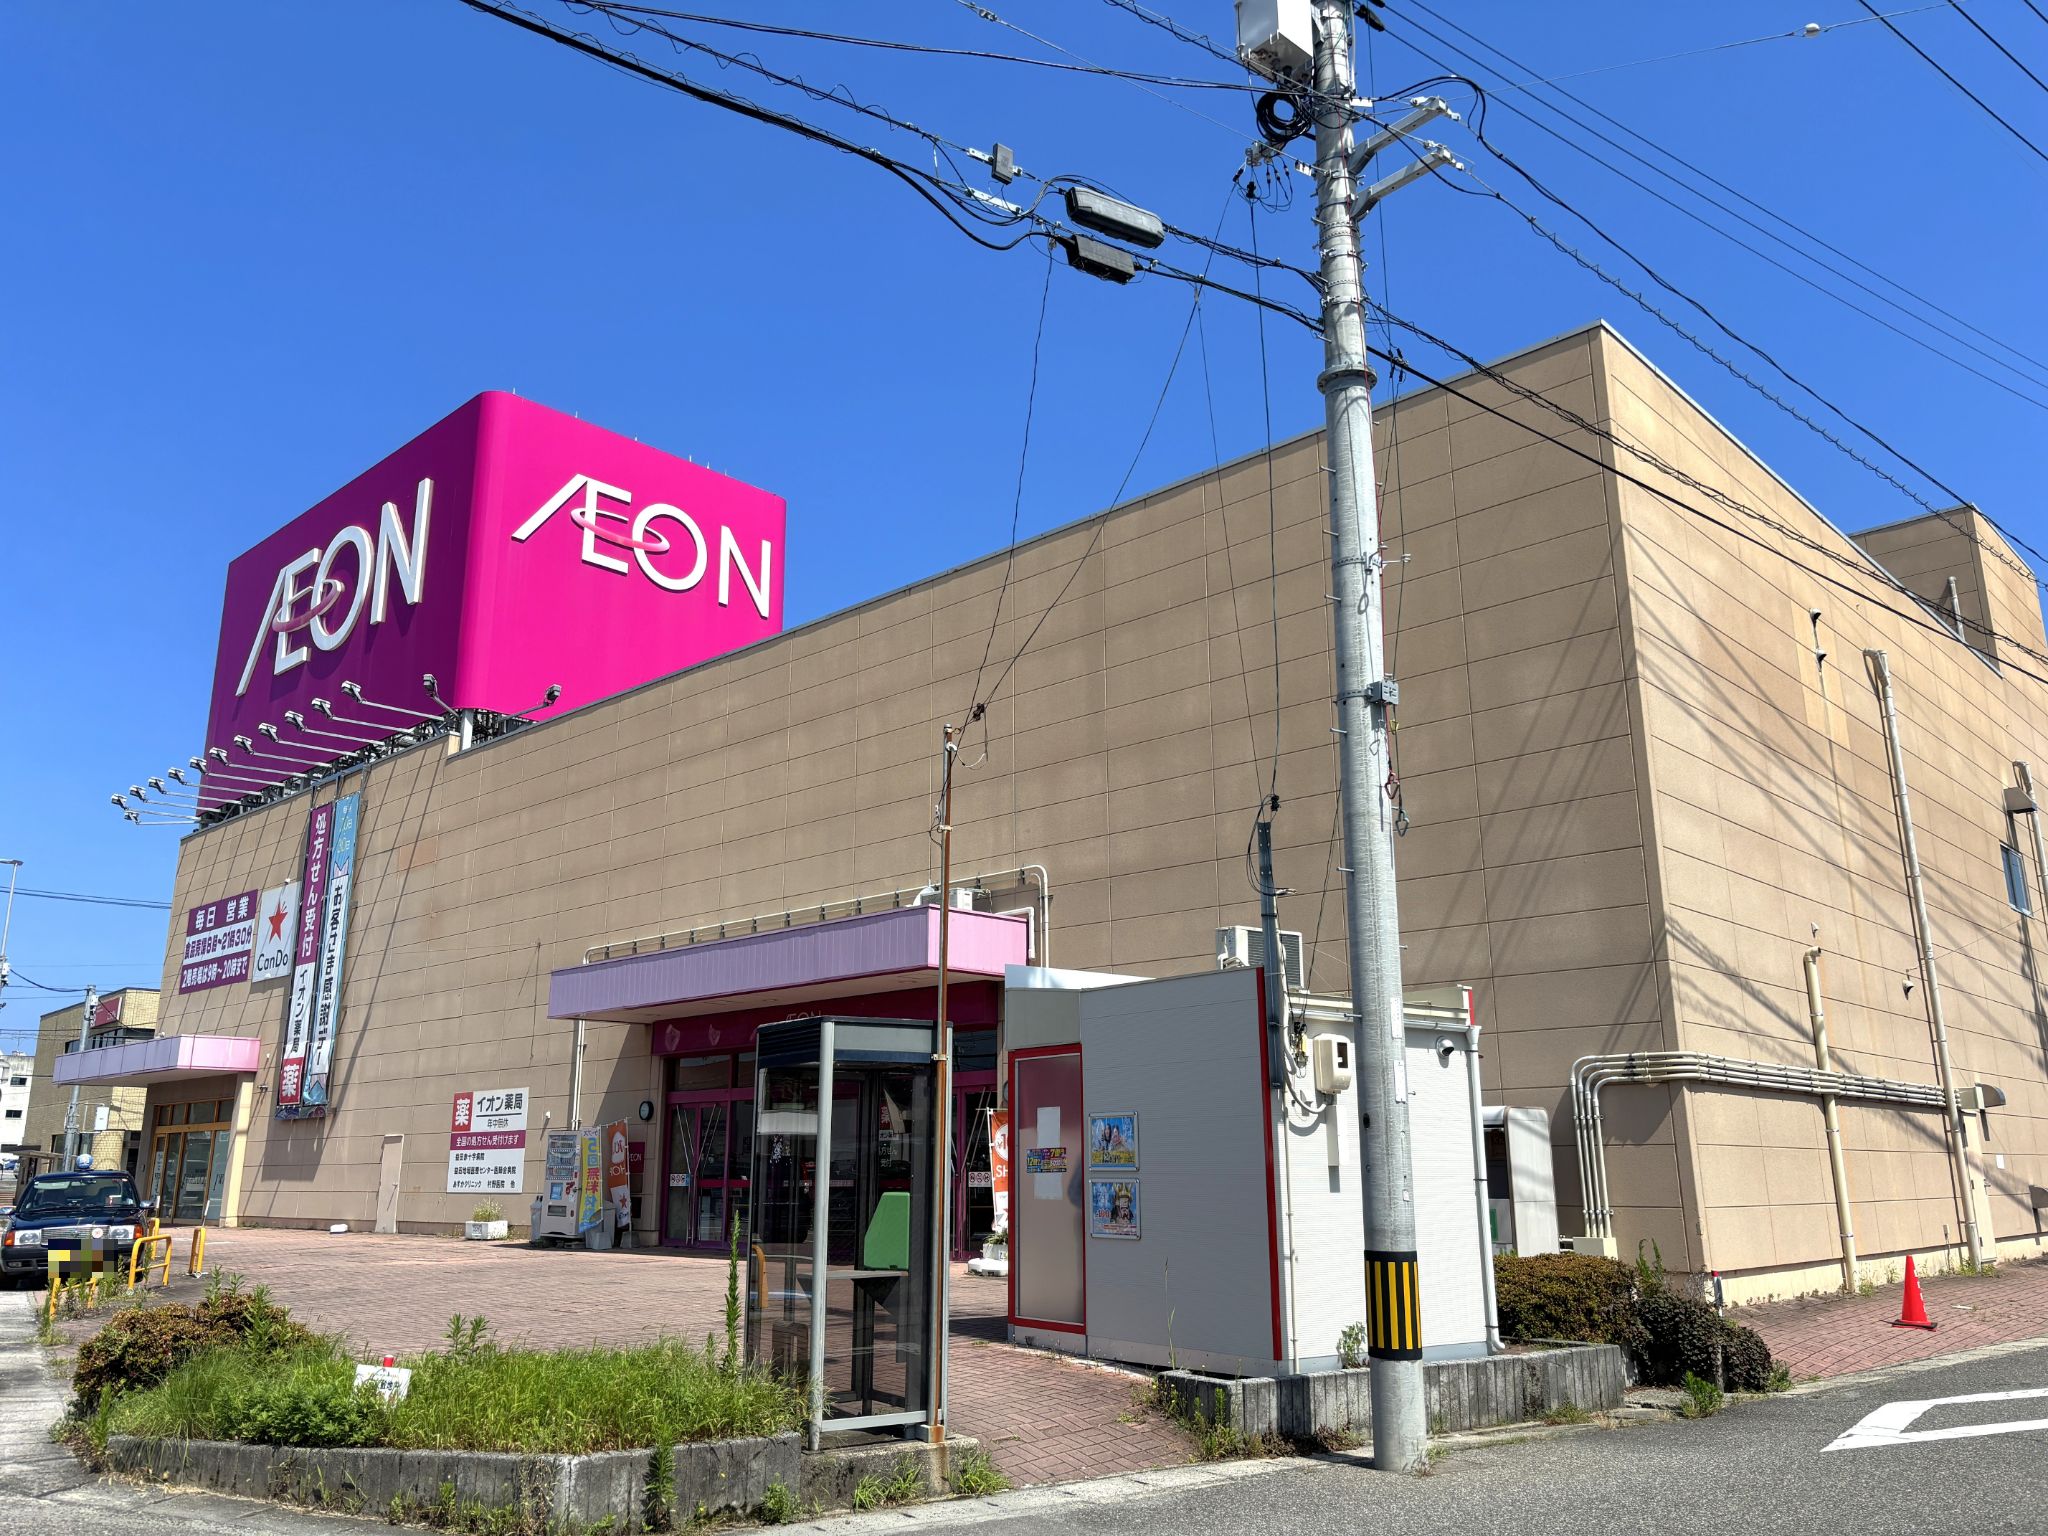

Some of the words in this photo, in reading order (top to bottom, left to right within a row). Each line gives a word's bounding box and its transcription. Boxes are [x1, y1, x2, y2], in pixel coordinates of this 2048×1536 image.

[302, 812, 326, 957] 処方せん受付
[195, 906, 216, 930] 毎日
[226, 896, 249, 922] 営業
[257, 949, 289, 971] CanDo
[316, 884, 342, 1065] お客さま感謝デー
[291, 969, 307, 1054] イオン薬局
[282, 1063, 299, 1097] 薬
[455, 1098, 470, 1126] 薬
[477, 1093, 523, 1112] イオン薬局
[456, 1135, 519, 1147] 全国の処方せん受付けます
